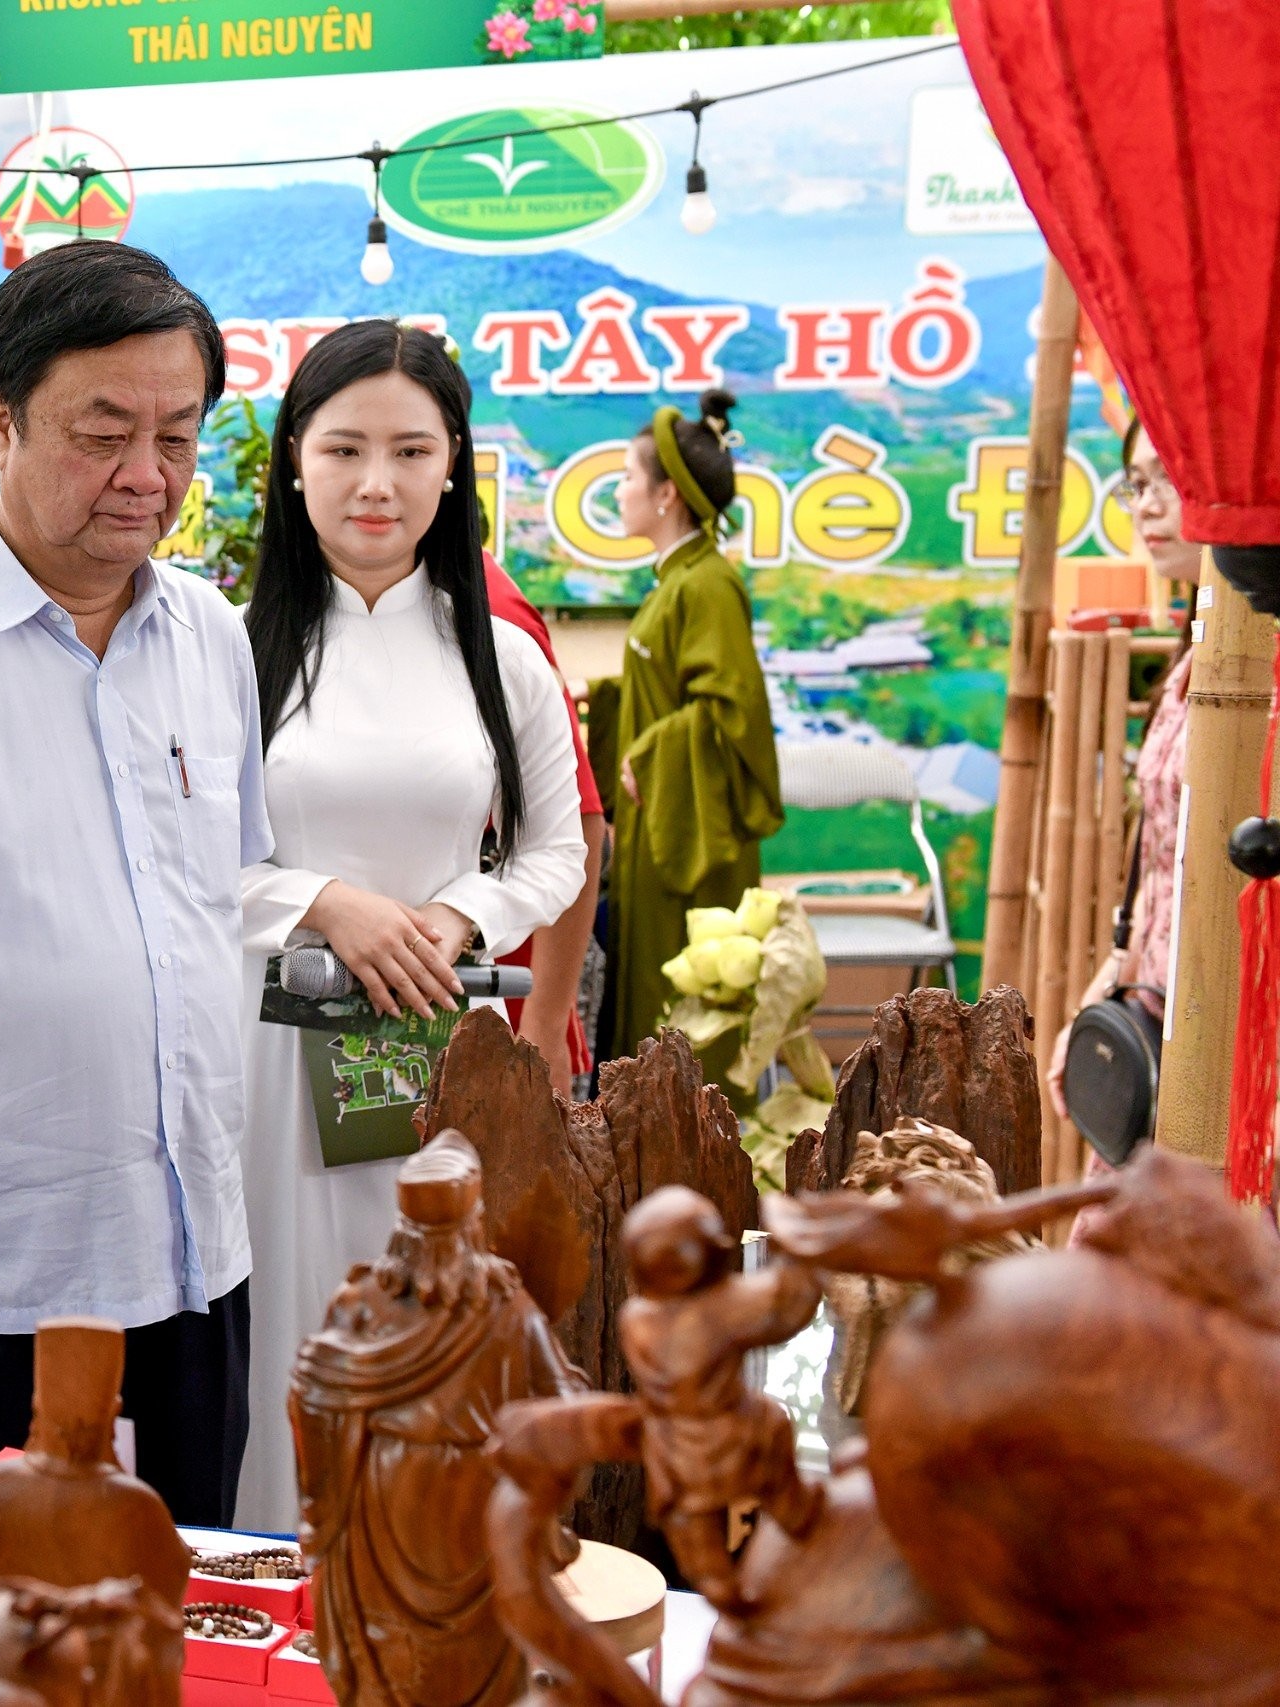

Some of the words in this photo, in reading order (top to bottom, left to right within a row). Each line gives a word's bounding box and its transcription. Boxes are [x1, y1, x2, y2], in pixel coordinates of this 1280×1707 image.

[127, 15, 209, 64] THÁI
[221, 6, 373, 58] NGUYÊN
[479, 293, 745, 388] TÂY
[782, 263, 973, 382] HỒ
